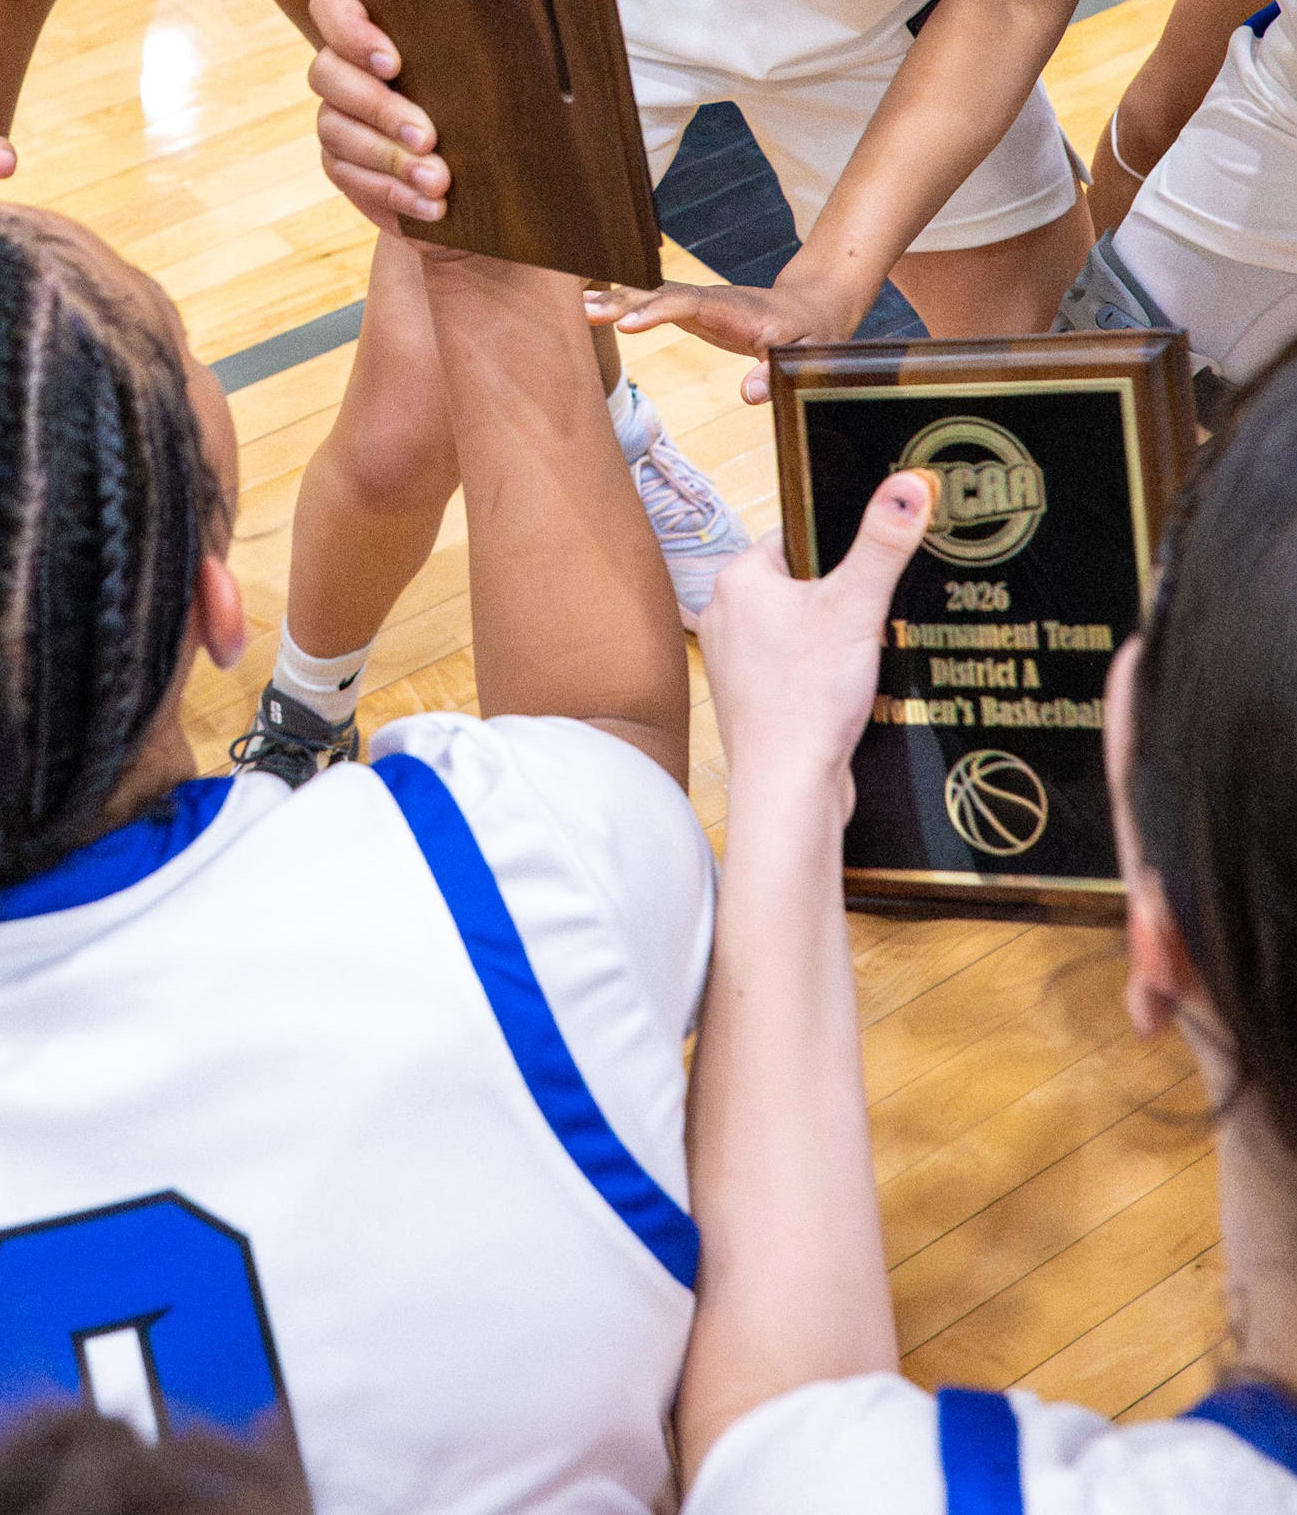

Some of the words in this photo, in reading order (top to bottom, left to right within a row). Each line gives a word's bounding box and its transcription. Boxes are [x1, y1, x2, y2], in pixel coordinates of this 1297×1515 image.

[945, 580, 1011, 611] 2026
[891, 619, 1040, 649] Tournament
[1041, 620, 1113, 651] Team
[929, 657, 1018, 688] District
[1022, 657, 1041, 688] A
